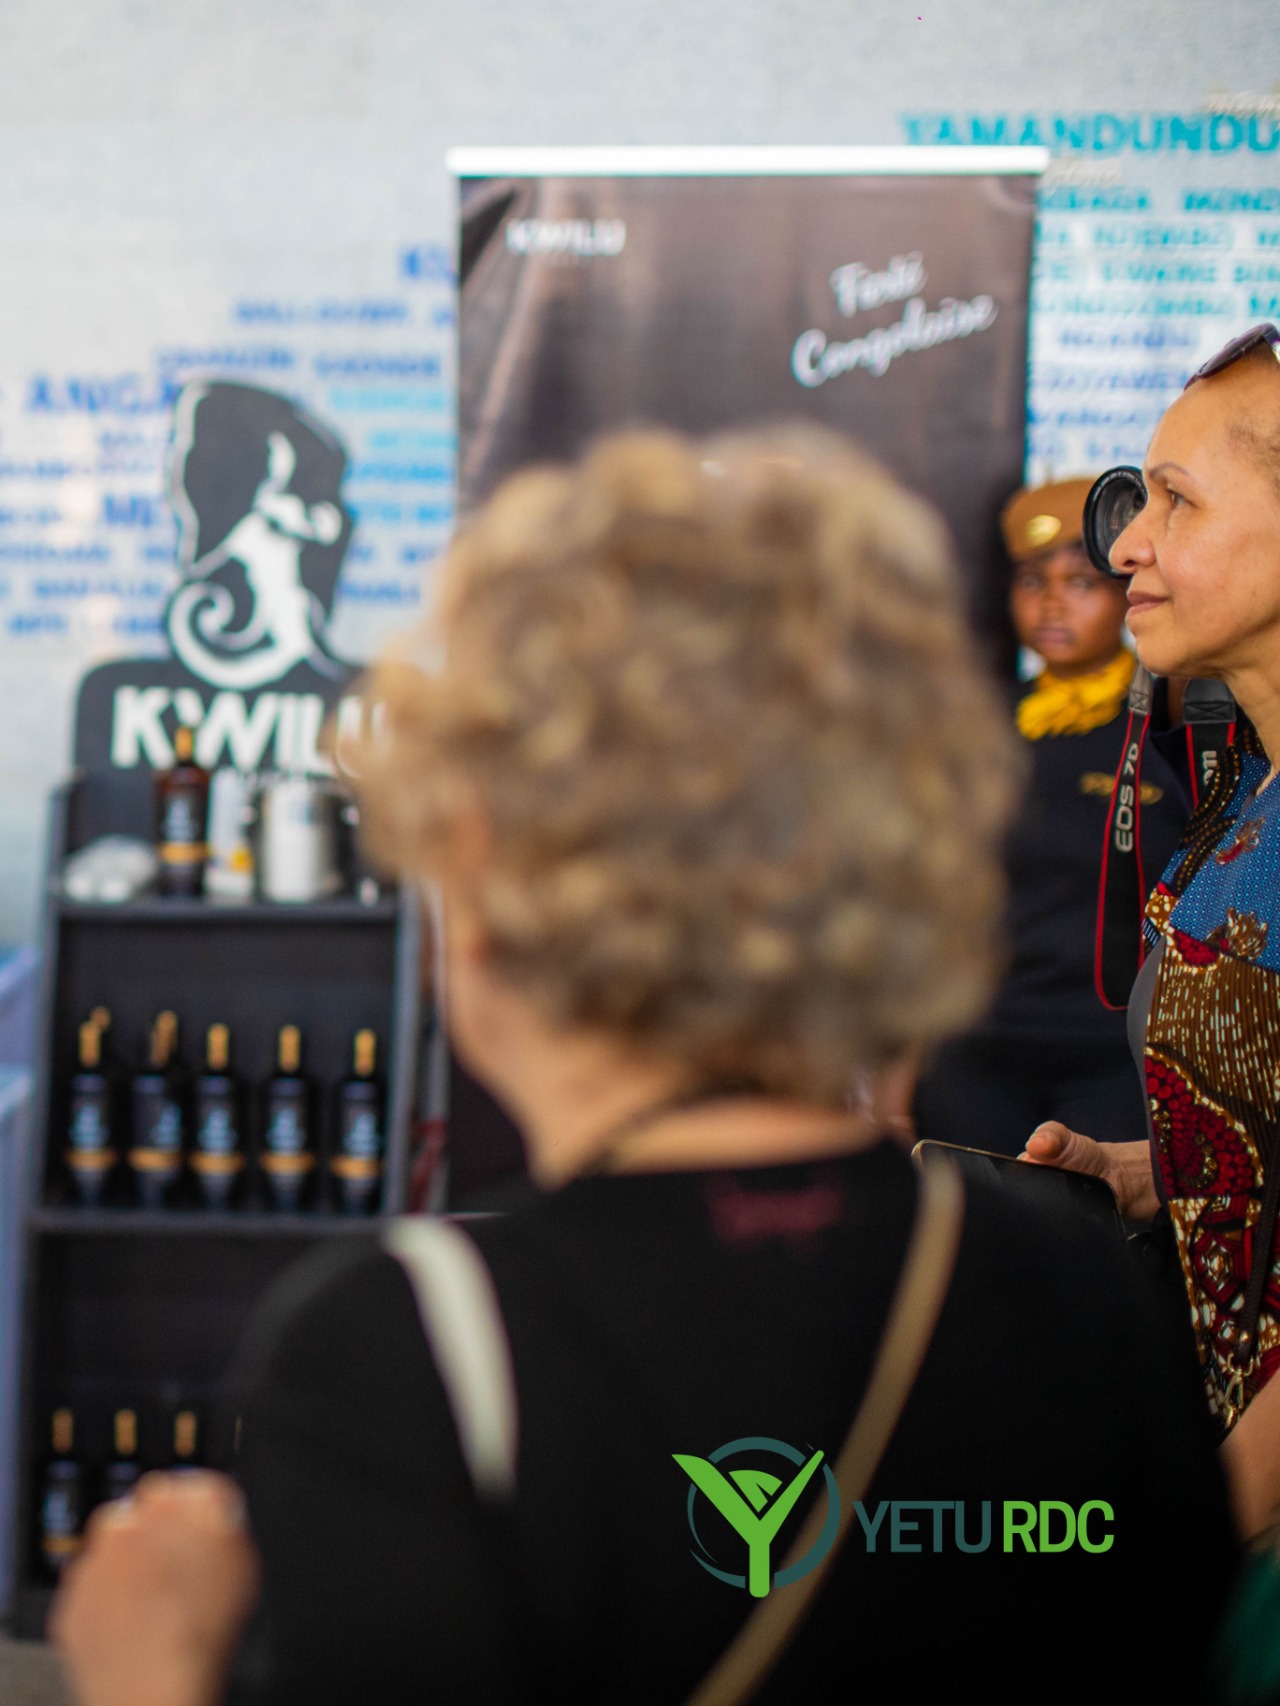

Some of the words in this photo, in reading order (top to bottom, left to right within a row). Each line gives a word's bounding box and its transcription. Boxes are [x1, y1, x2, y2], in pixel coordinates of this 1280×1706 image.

[792, 294, 999, 388] Congolaise
[1123, 742, 1139, 776] 7D
[1114, 785, 1135, 852] EOS
